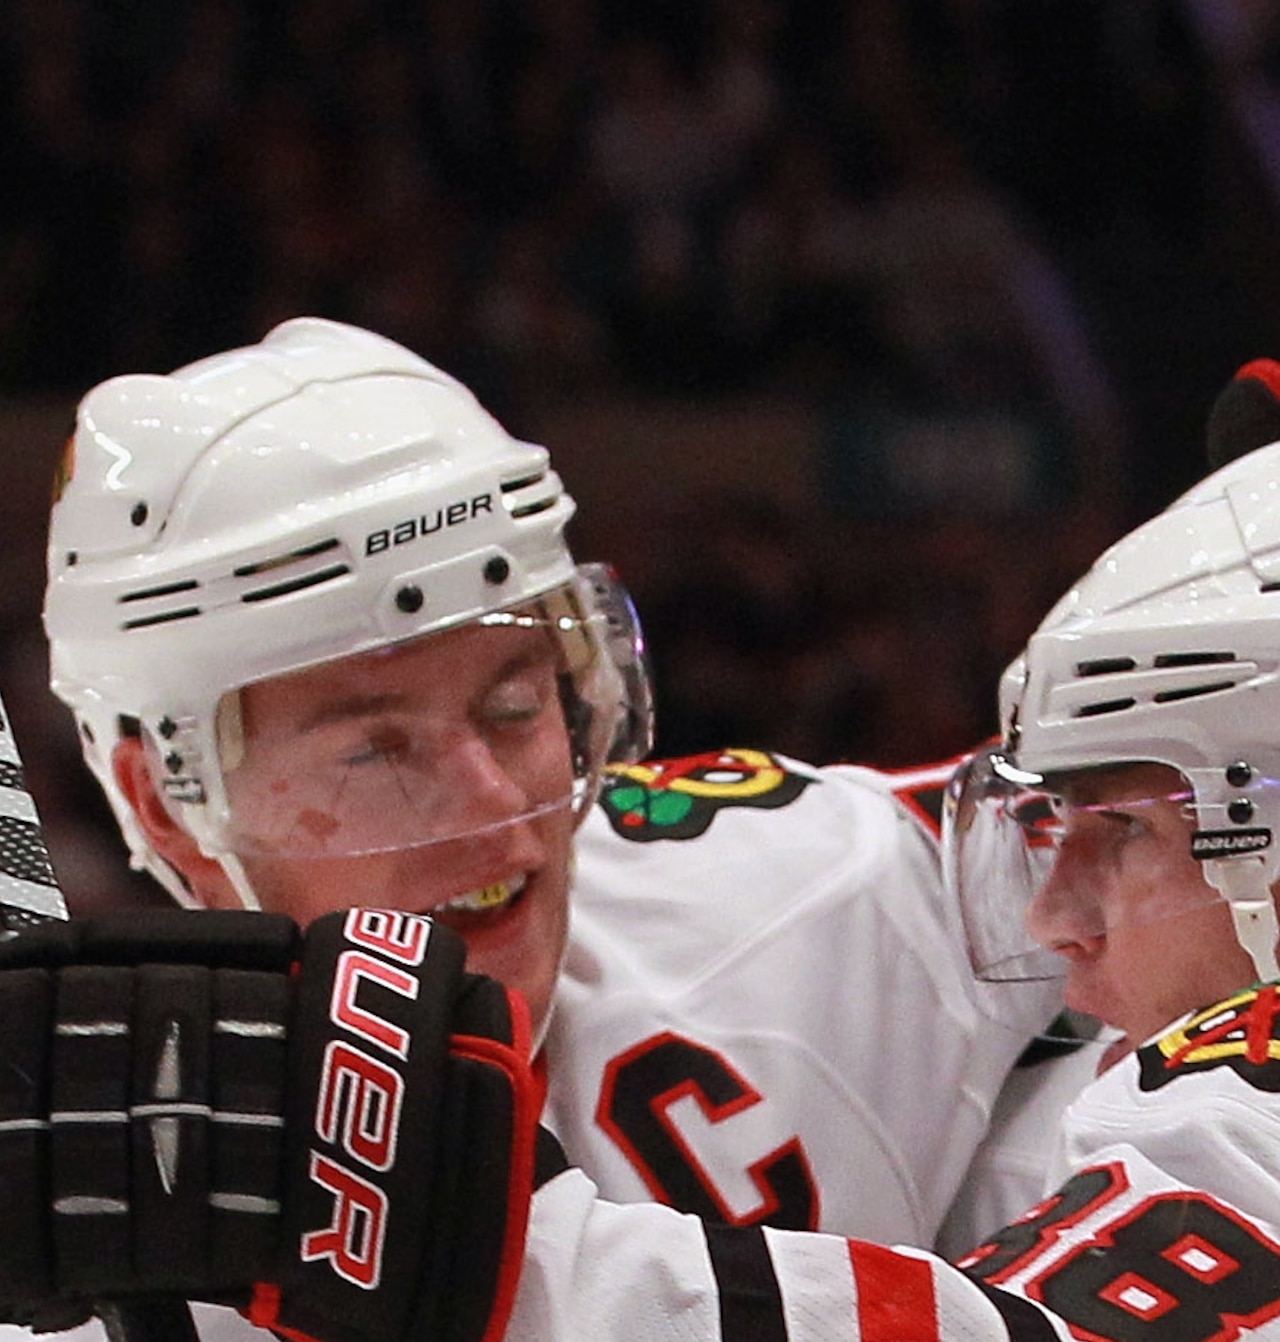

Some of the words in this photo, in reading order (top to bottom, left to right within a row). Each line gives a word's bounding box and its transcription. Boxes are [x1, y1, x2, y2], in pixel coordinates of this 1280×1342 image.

[364, 492, 494, 558] BAUER
[300, 906, 434, 1291] AUER
[593, 1028, 821, 1233] C
